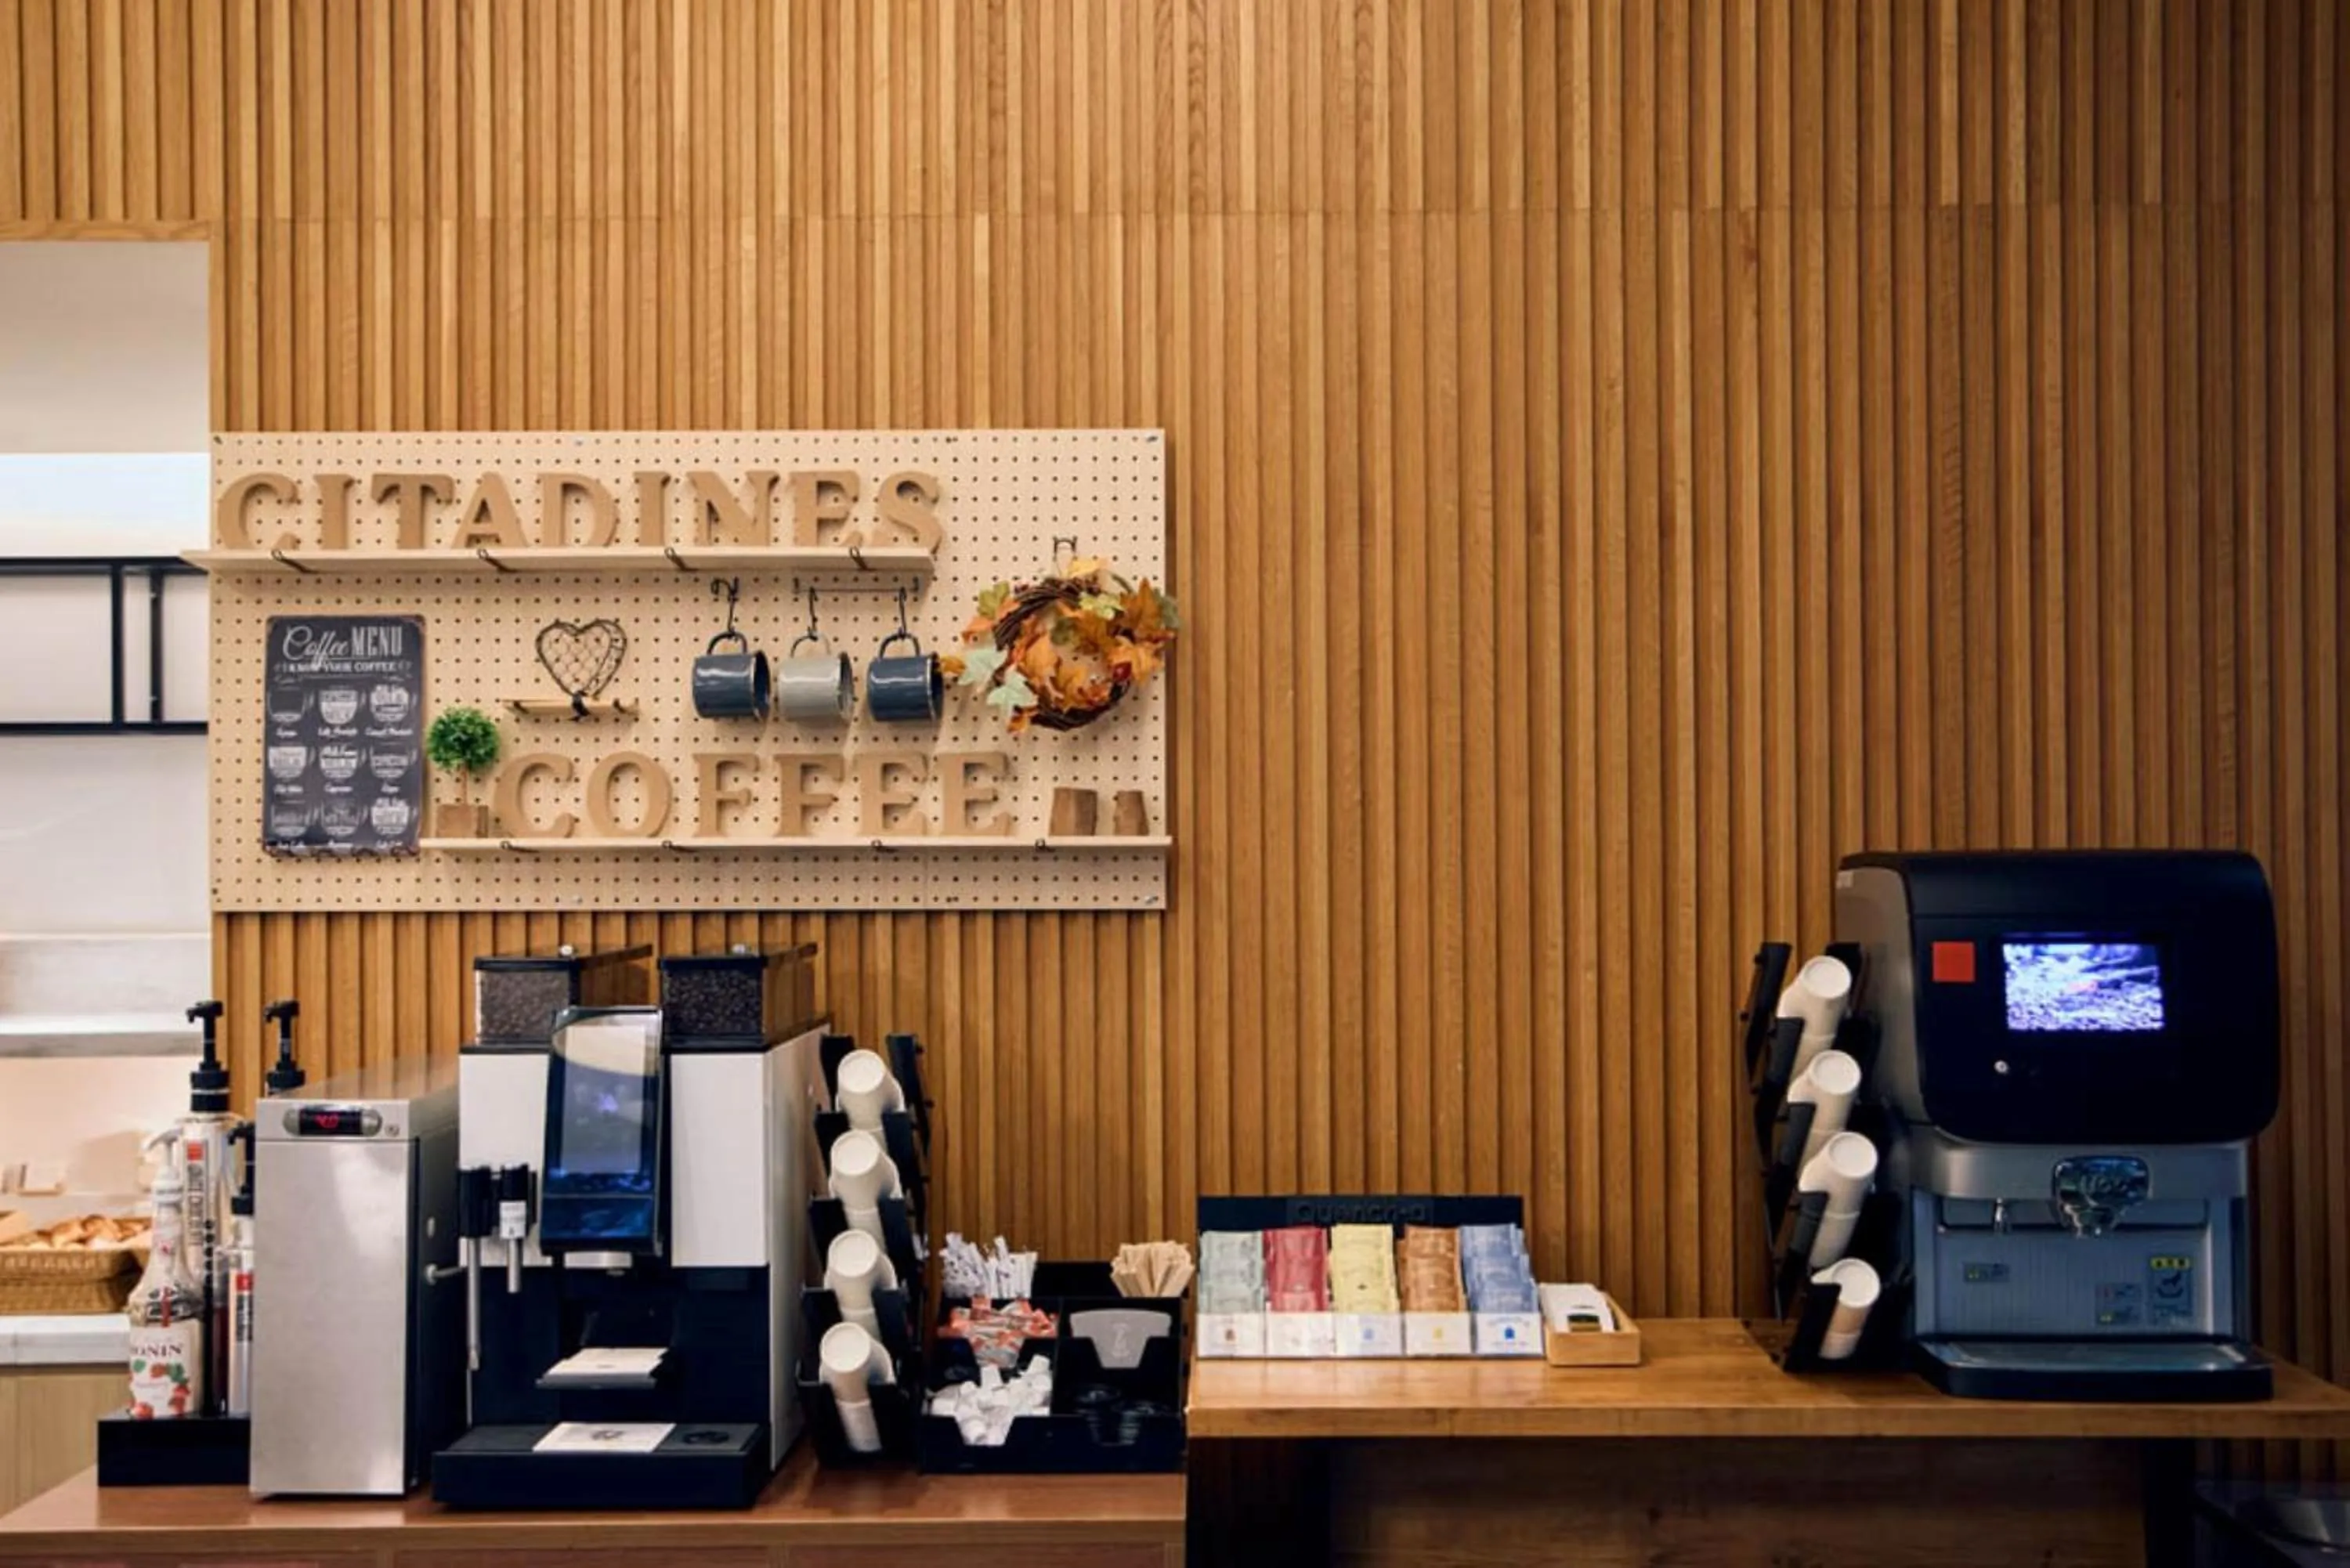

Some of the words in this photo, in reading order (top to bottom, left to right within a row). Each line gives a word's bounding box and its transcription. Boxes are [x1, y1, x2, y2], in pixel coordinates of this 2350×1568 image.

[217, 470, 944, 553] CITADINES
[283, 626, 348, 666] Coffee
[352, 626, 403, 656] MENU
[493, 750, 1017, 838] COFFEE
